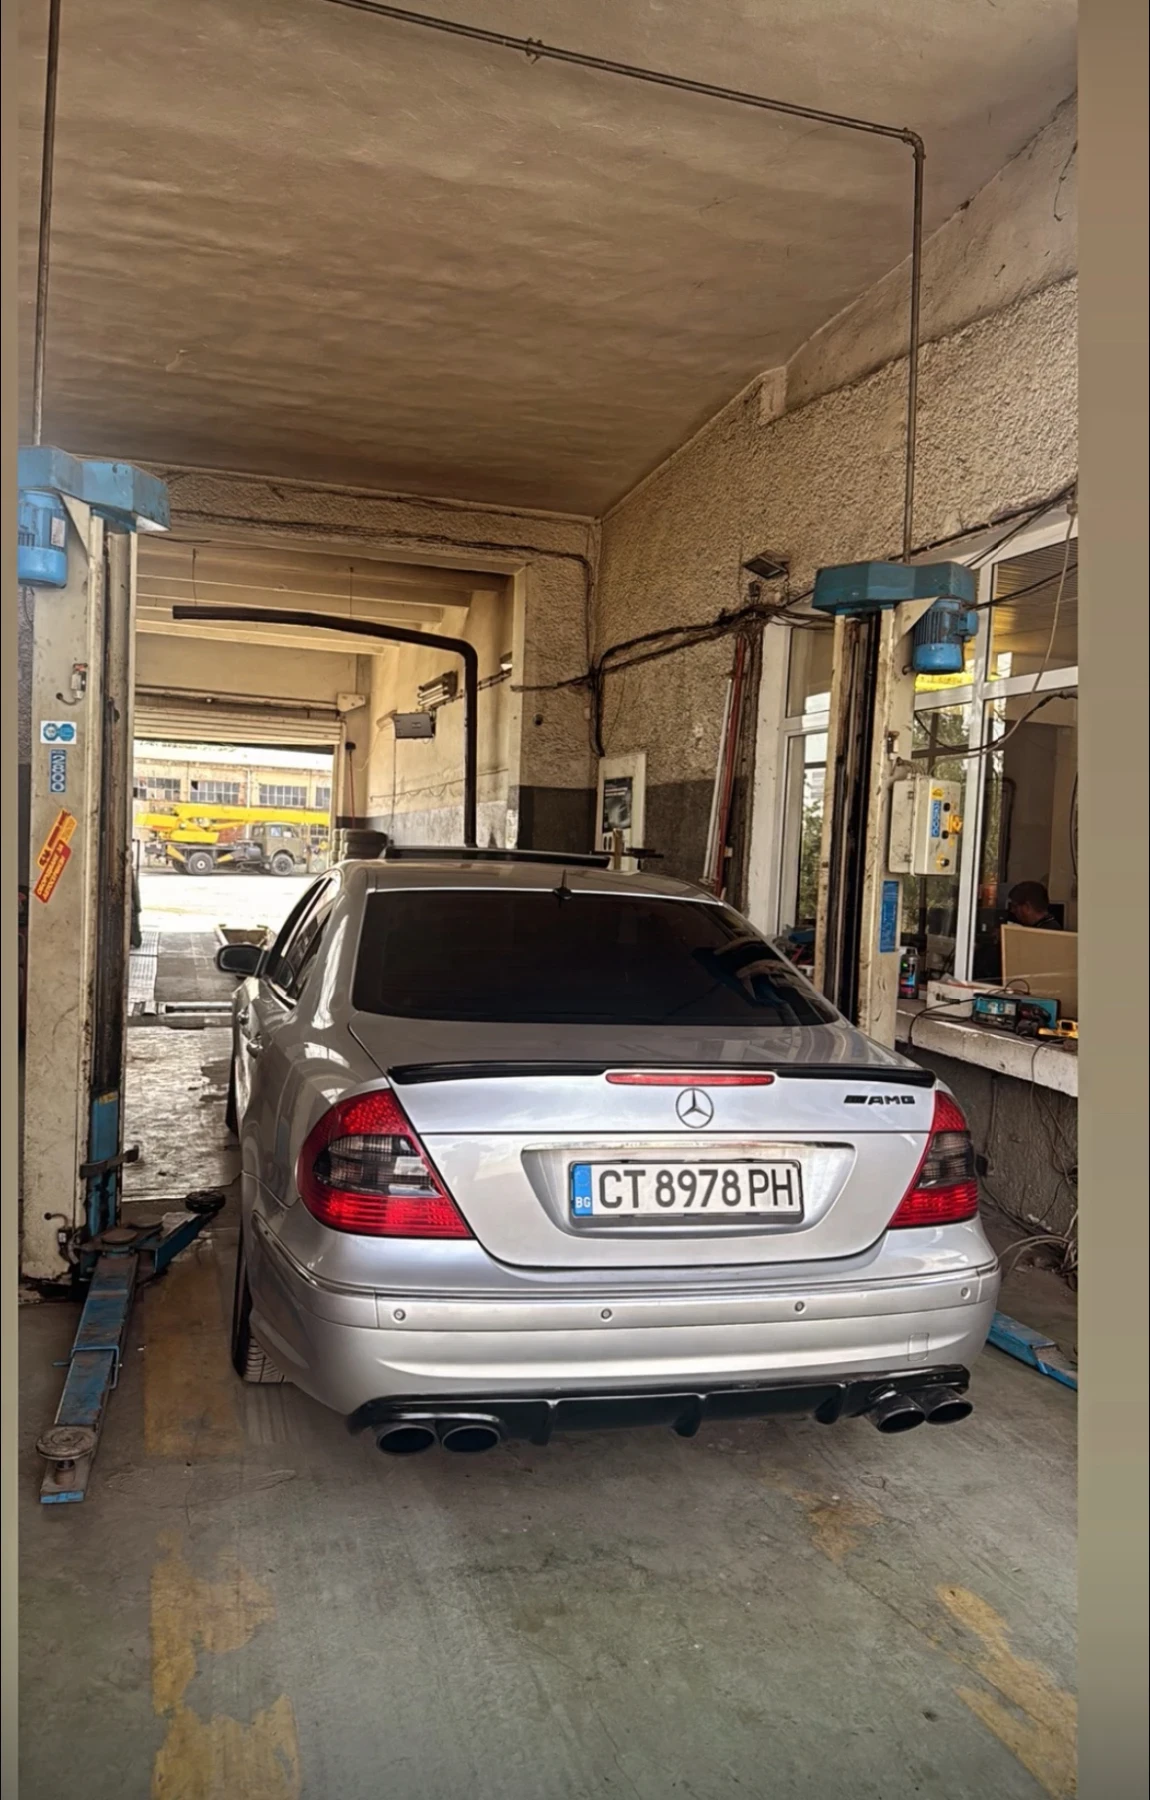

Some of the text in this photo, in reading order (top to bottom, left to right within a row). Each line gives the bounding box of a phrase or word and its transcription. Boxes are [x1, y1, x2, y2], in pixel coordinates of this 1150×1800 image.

[52, 754, 65, 792] 2800
[868, 1095, 915, 1105] AMG
[599, 1169, 793, 1208] CT 8978 PH
[575, 1196, 591, 1208] BG
